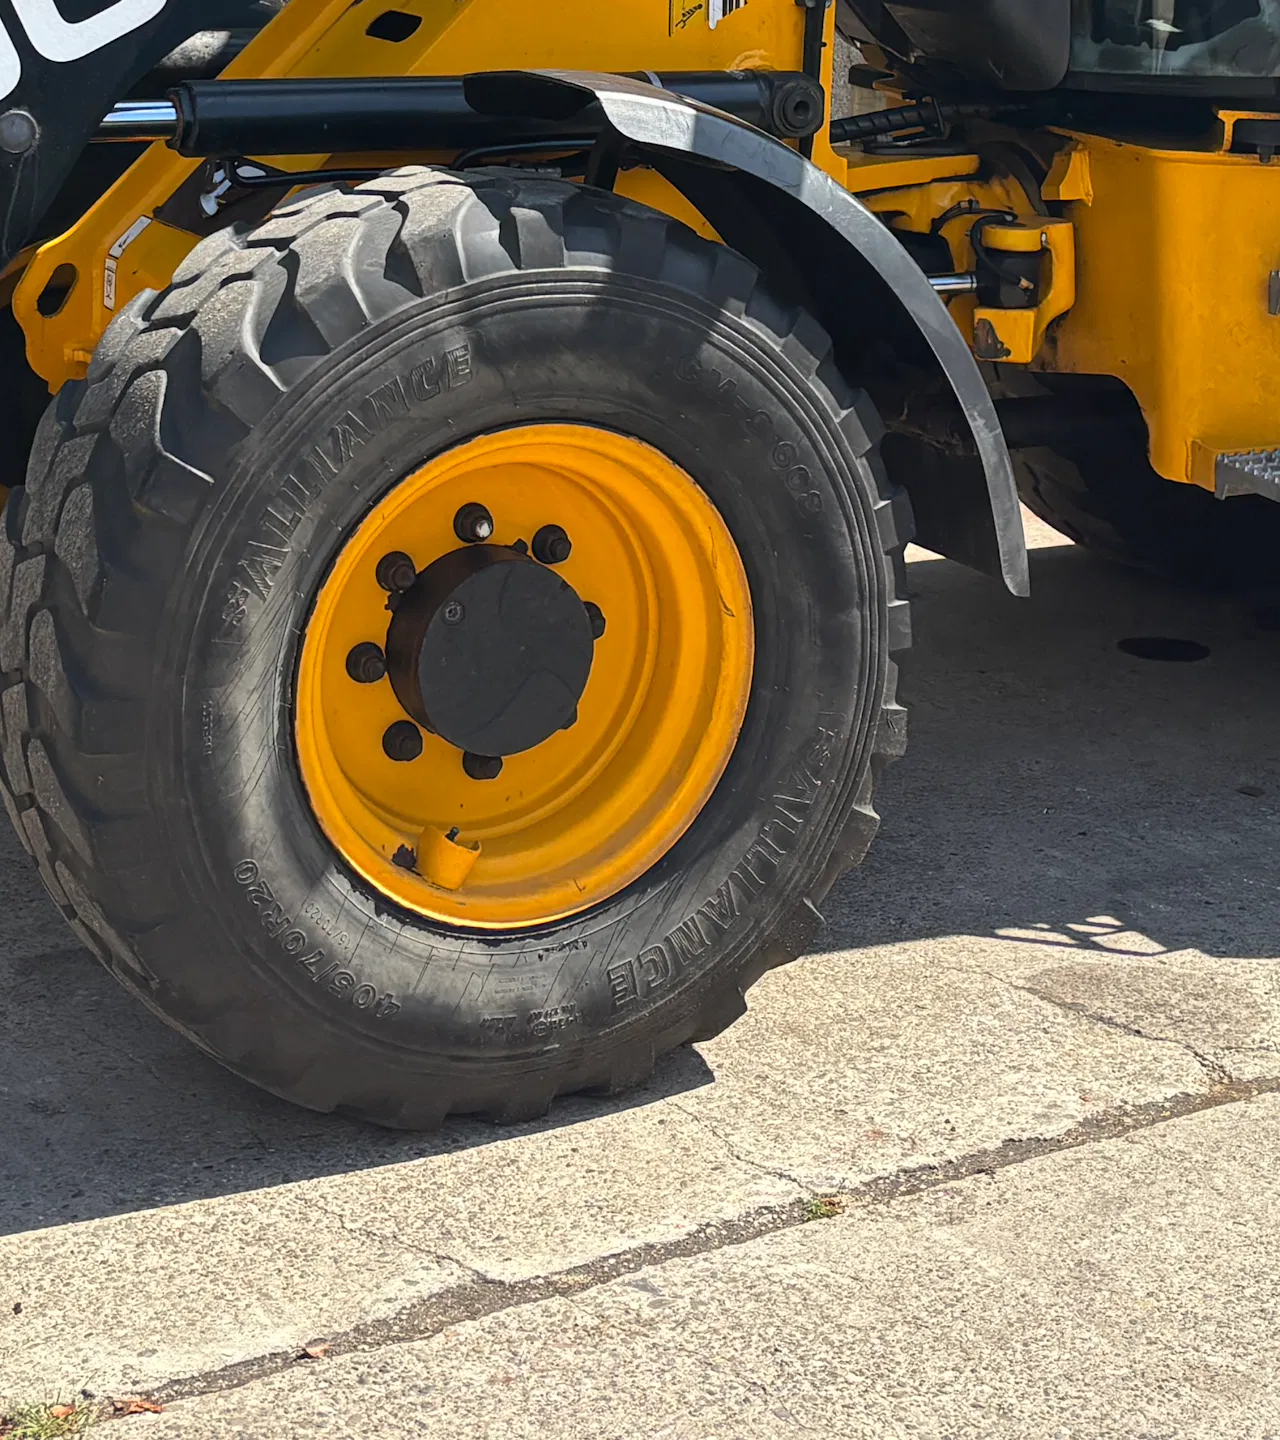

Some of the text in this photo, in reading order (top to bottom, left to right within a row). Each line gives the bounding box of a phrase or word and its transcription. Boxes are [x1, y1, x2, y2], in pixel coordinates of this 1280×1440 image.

[238, 344, 472, 604] ALLIANCE
[233, 858, 402, 1018] 405/70R20
[607, 760, 822, 1007] ALLIANCE
